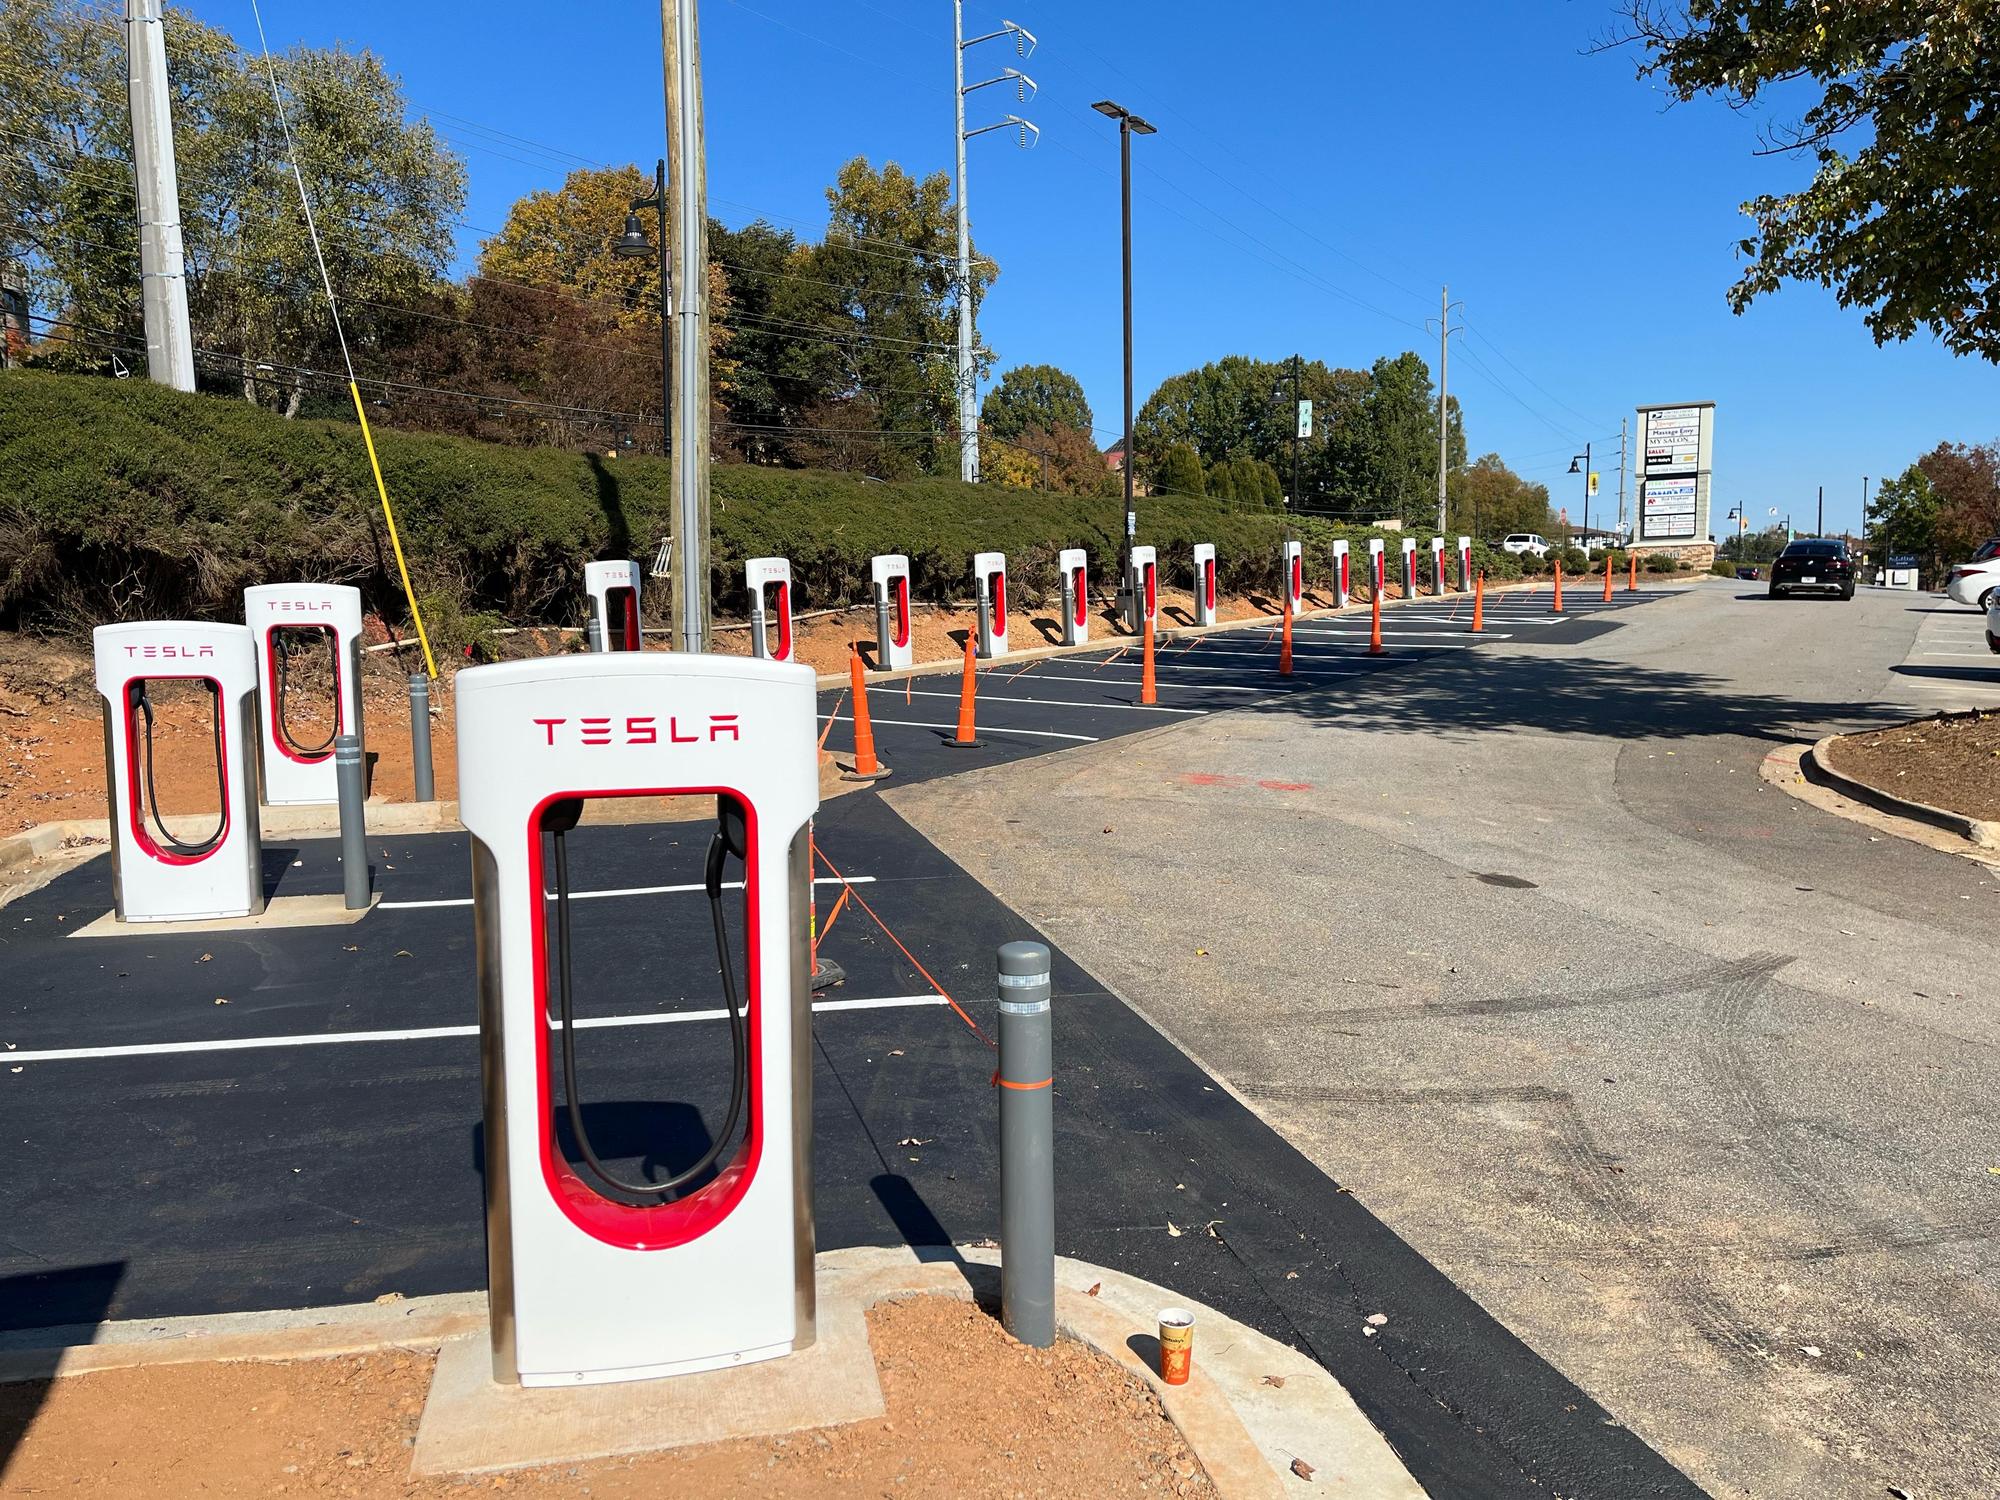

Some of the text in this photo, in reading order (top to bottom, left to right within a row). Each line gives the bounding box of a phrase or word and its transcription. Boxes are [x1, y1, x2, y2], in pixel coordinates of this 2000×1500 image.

[267, 601, 332, 611] TESLA
[123, 645, 214, 658] TESLA
[532, 714, 740, 746] TESLA
